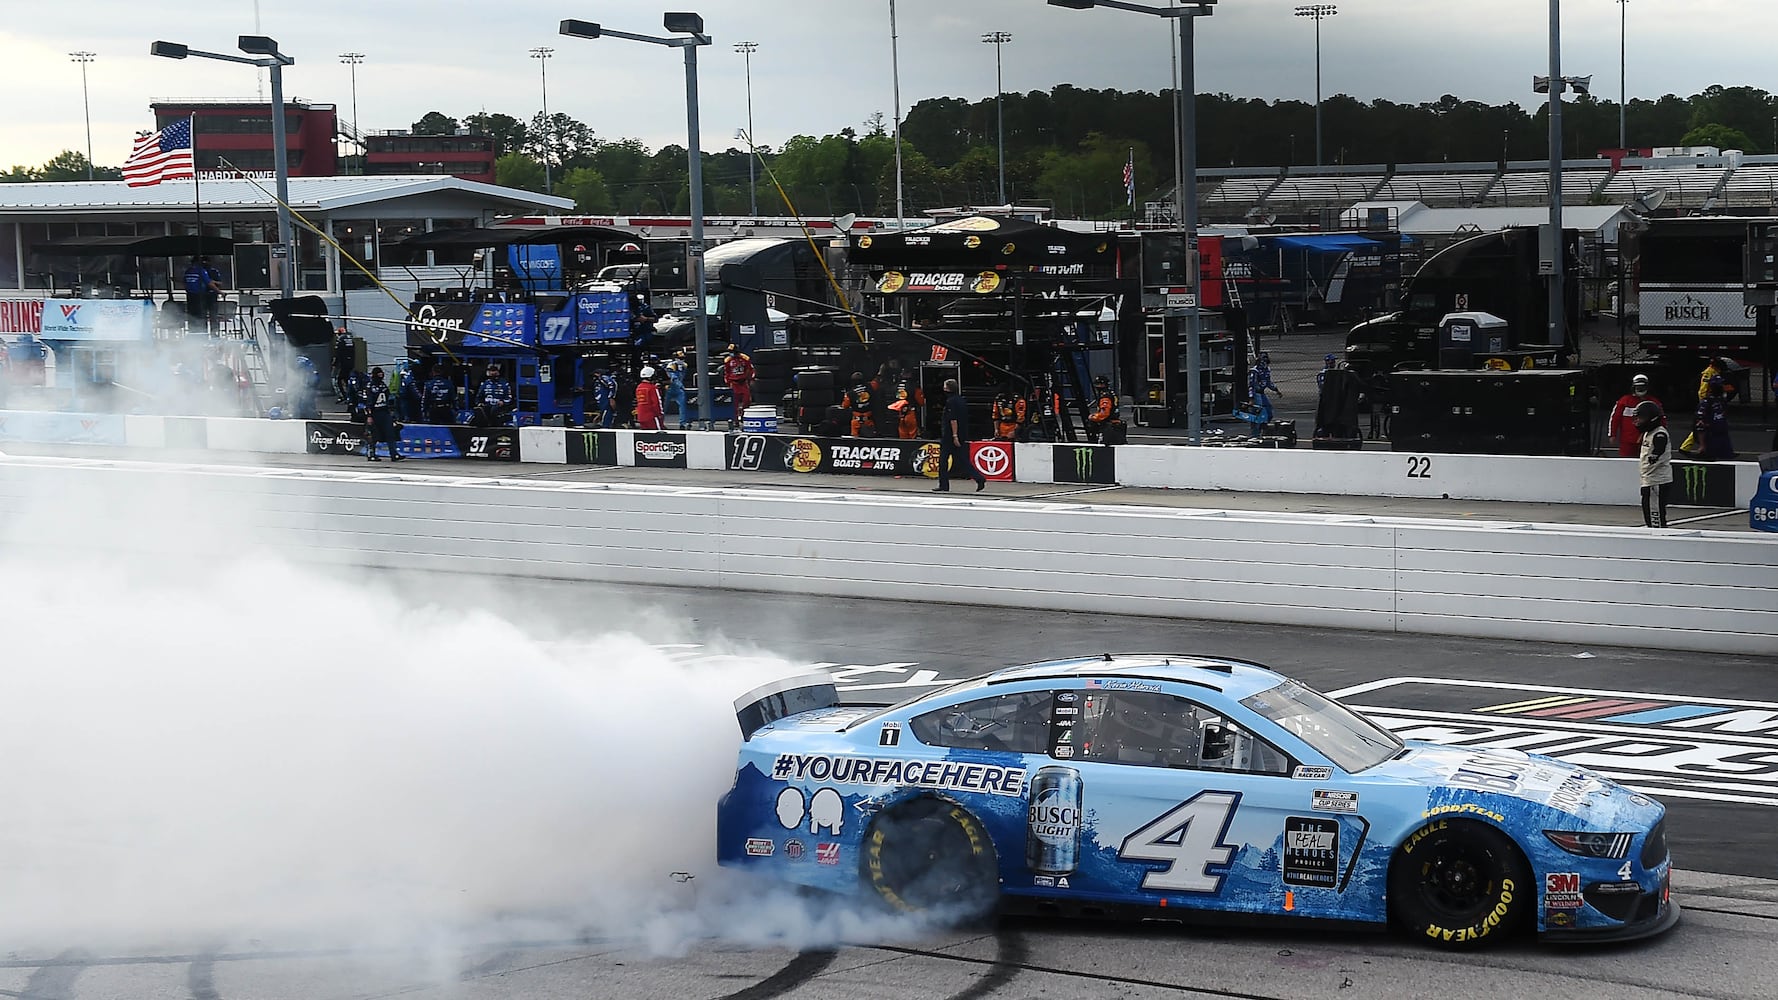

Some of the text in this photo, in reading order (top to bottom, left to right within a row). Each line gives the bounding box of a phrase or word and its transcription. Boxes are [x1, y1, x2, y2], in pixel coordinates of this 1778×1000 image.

[909, 273, 964, 285] TRACKER
[1665, 305, 1711, 321] BUSCH
[411, 305, 463, 344] Kroger
[310, 430, 334, 450] Kroger
[336, 432, 361, 451] Kroger
[469, 436, 489, 452] 37
[730, 434, 766, 471] 19
[830, 445, 901, 460] TRACKER
[833, 459, 861, 468] BOATS
[1407, 456, 1431, 478] 22
[774, 754, 1025, 794] #YOURFACEHERE
[1331, 800, 1351, 808] SERIES
[1421, 803, 1504, 822] GOODYEAR
[1029, 806, 1080, 828] BUSCH
[1036, 824, 1071, 836] LIGHT
[1300, 823, 1323, 832] THE
[1402, 819, 1448, 854] EAGLE
[1118, 789, 1243, 895] 4
[1295, 832, 1326, 848] REAL
[1286, 848, 1335, 860] HEROES
[1617, 860, 1632, 880] 4
[1547, 874, 1579, 893] 3M
[1426, 878, 1515, 942] GOODYEAR
